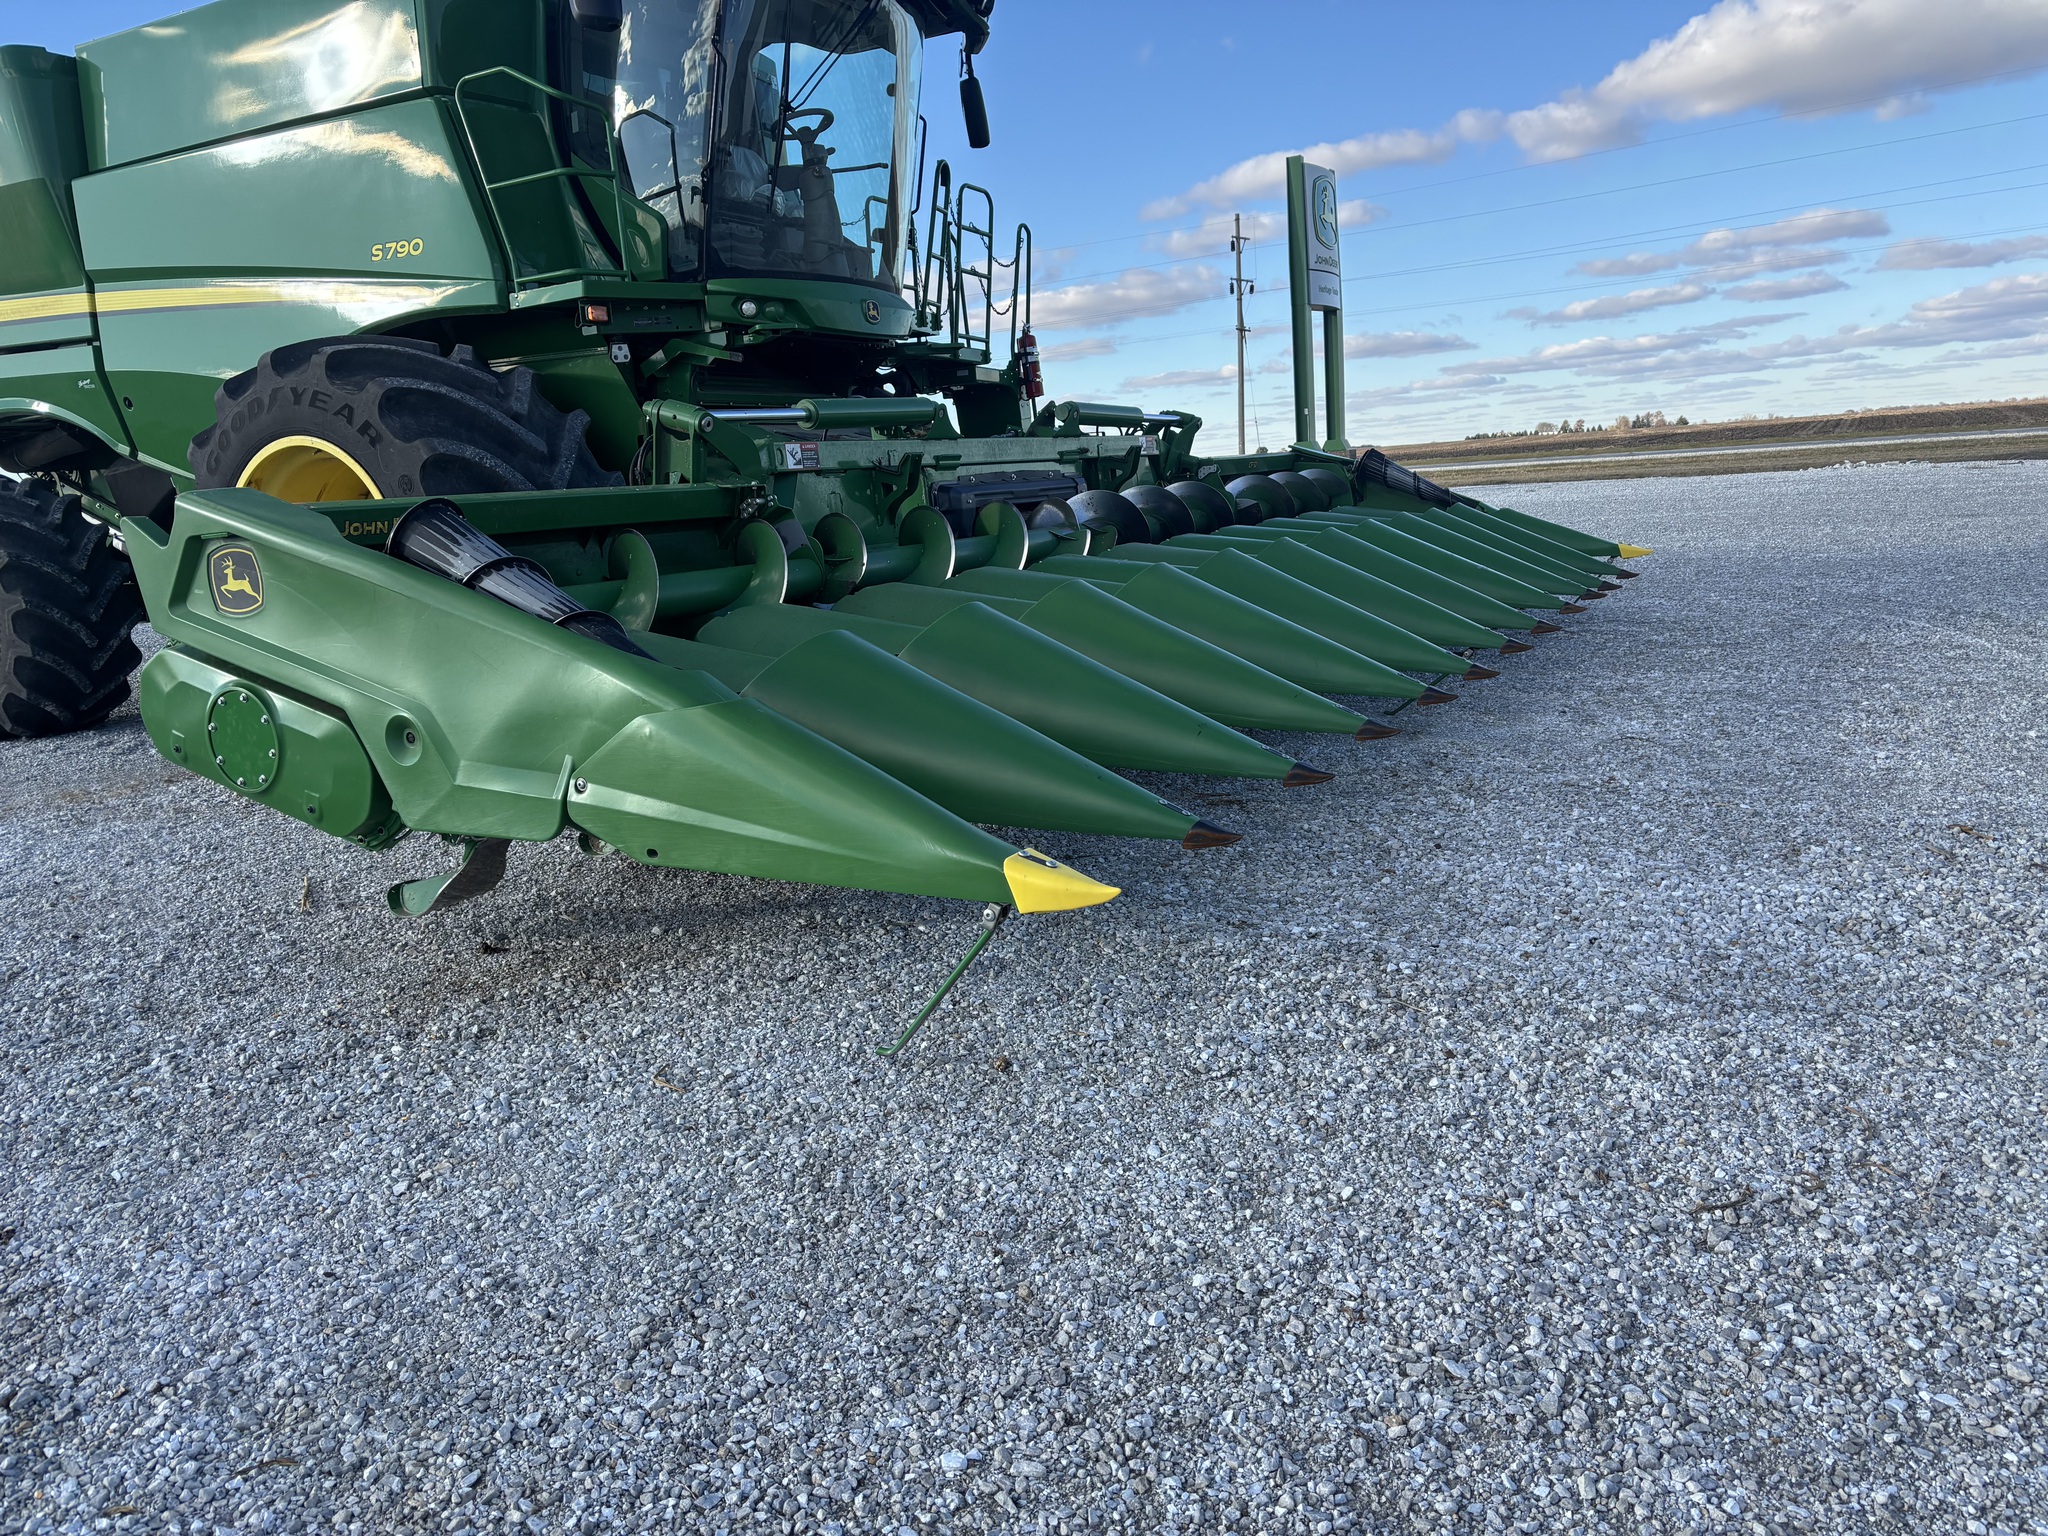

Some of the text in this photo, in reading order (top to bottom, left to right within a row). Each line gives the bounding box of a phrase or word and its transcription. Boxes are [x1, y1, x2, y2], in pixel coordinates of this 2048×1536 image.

[371, 237, 424, 262] S790
[206, 385, 383, 476] GOODYEAR
[341, 520, 389, 537] JOHN
